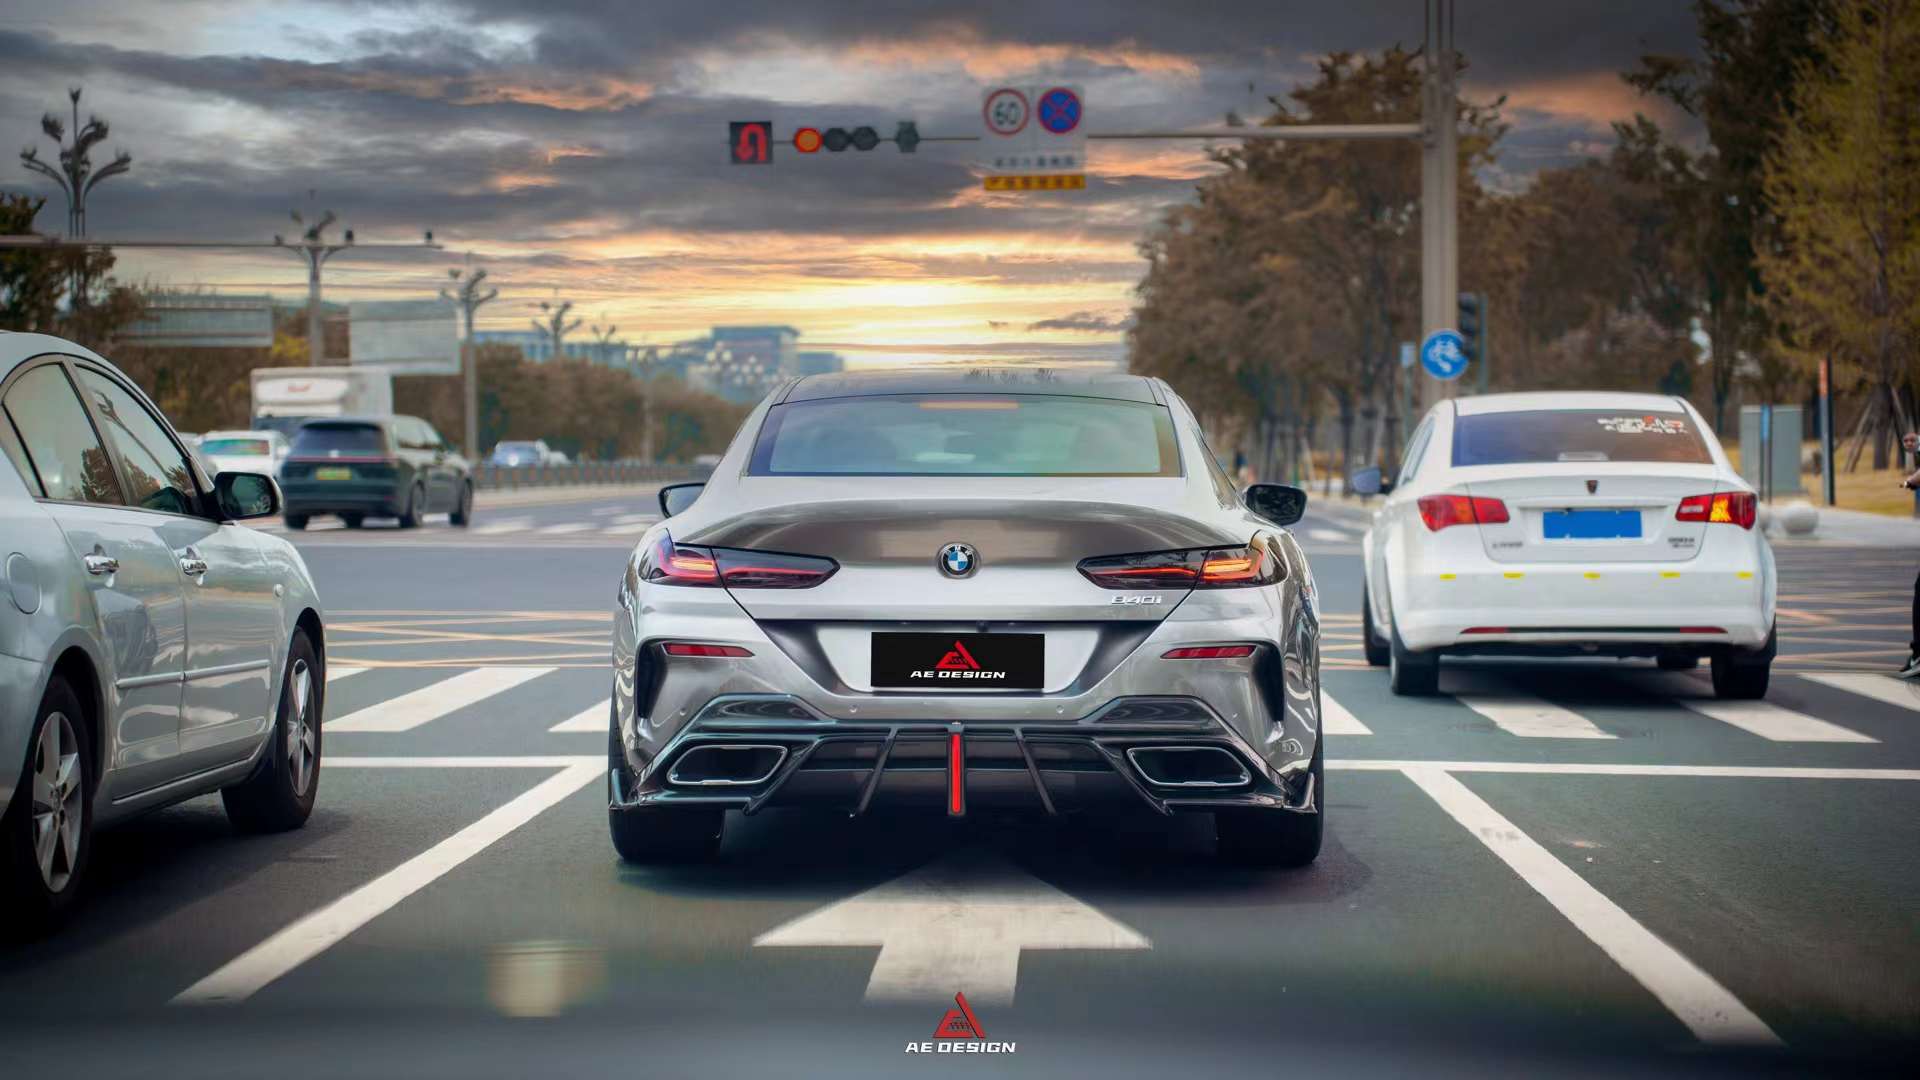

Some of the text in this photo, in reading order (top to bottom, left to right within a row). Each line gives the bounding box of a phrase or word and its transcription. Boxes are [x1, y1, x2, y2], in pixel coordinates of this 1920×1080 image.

[994, 101, 1019, 126] 60
[910, 670, 1006, 679] AE DESIGN
